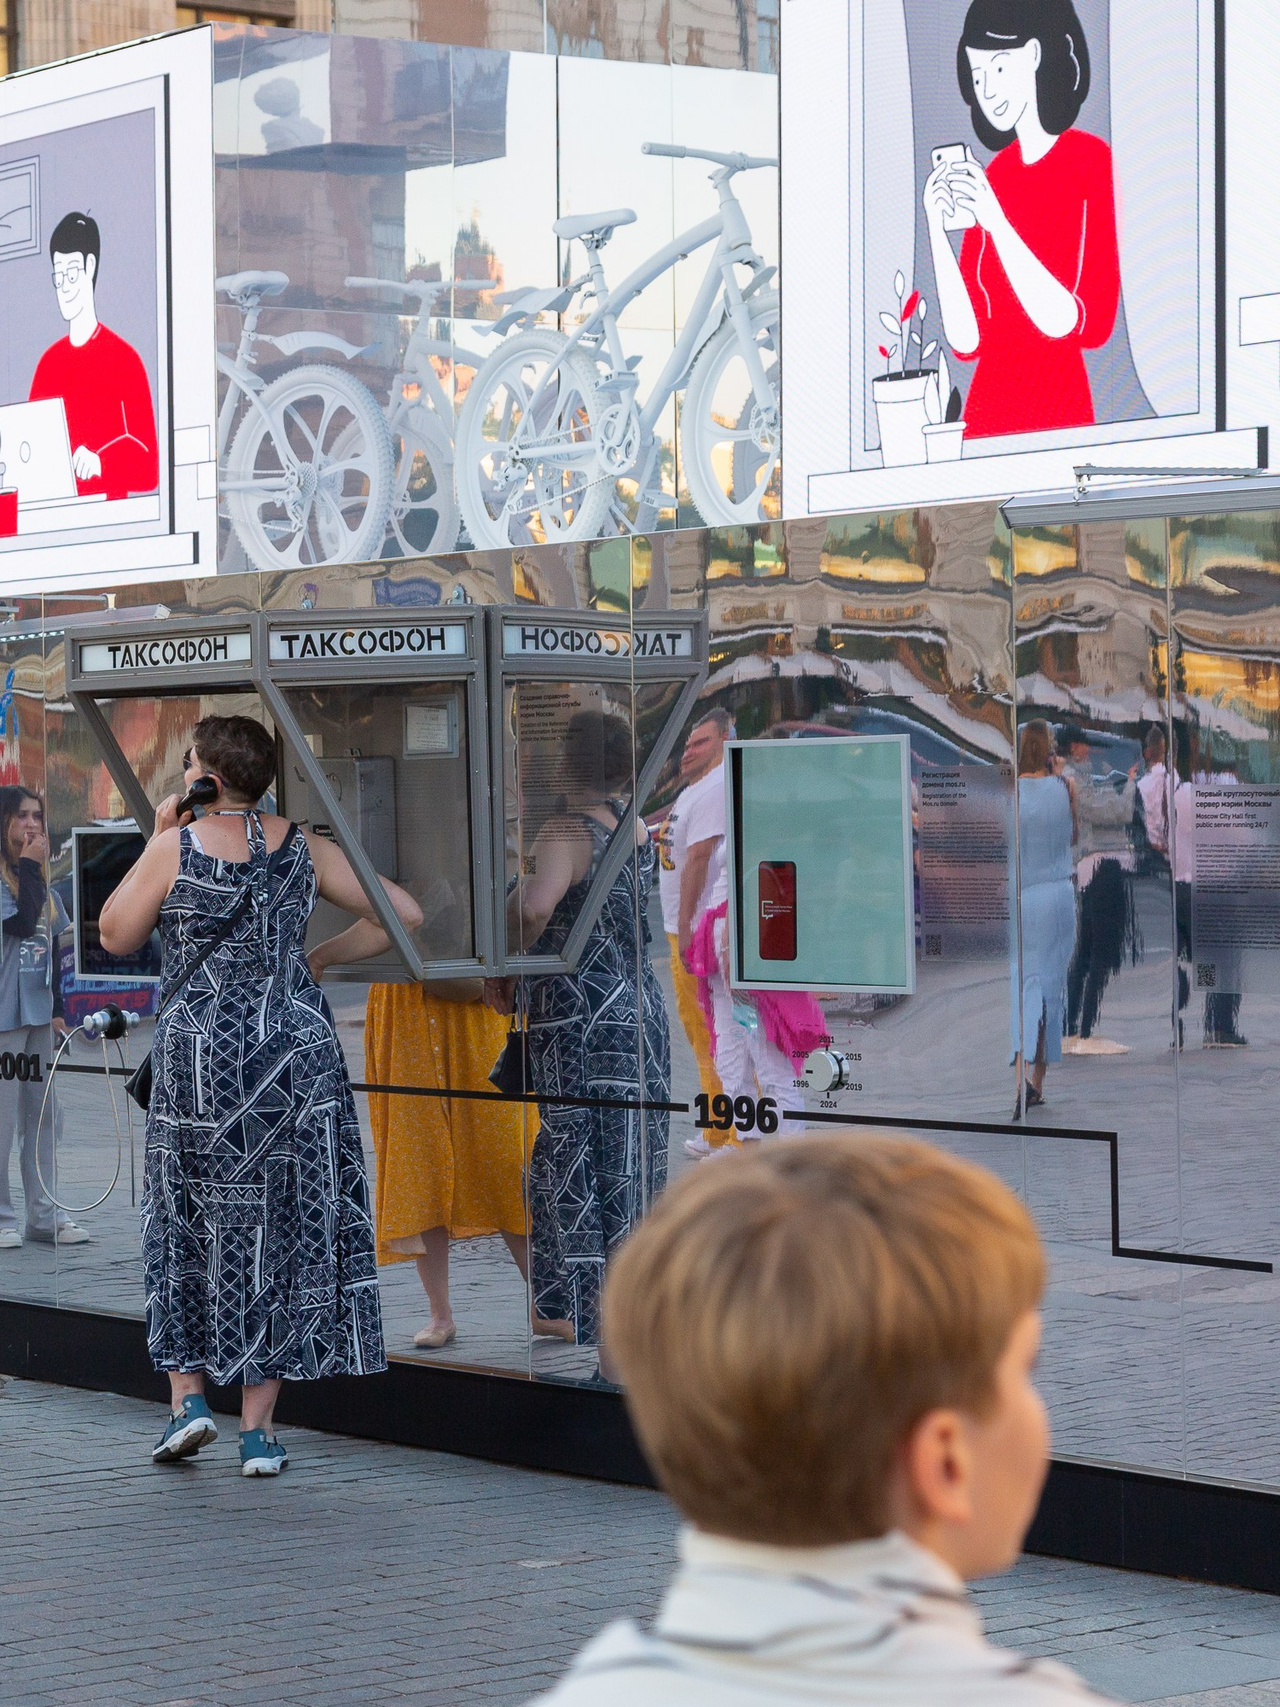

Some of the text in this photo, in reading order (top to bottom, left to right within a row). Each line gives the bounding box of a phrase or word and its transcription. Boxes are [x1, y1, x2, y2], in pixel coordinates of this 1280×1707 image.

[280, 627, 446, 659] ТАКСОФОН
[107, 636, 228, 669] ТАКСОФОН
[921, 771, 961, 779] Регистрация
[1195, 789, 1280, 799] Первый круглосуточный
[1195, 800, 1272, 809] сервер мэрии Москвы
[819, 1036, 835, 1044] 2011
[792, 1050, 810, 1059] 2005
[845, 1053, 862, 1061] 2015
[792, 1080, 810, 1088] 1996
[845, 1083, 863, 1091] 2019
[820, 1100, 837, 1108] 2024
[694, 1093, 779, 1134] 1996
